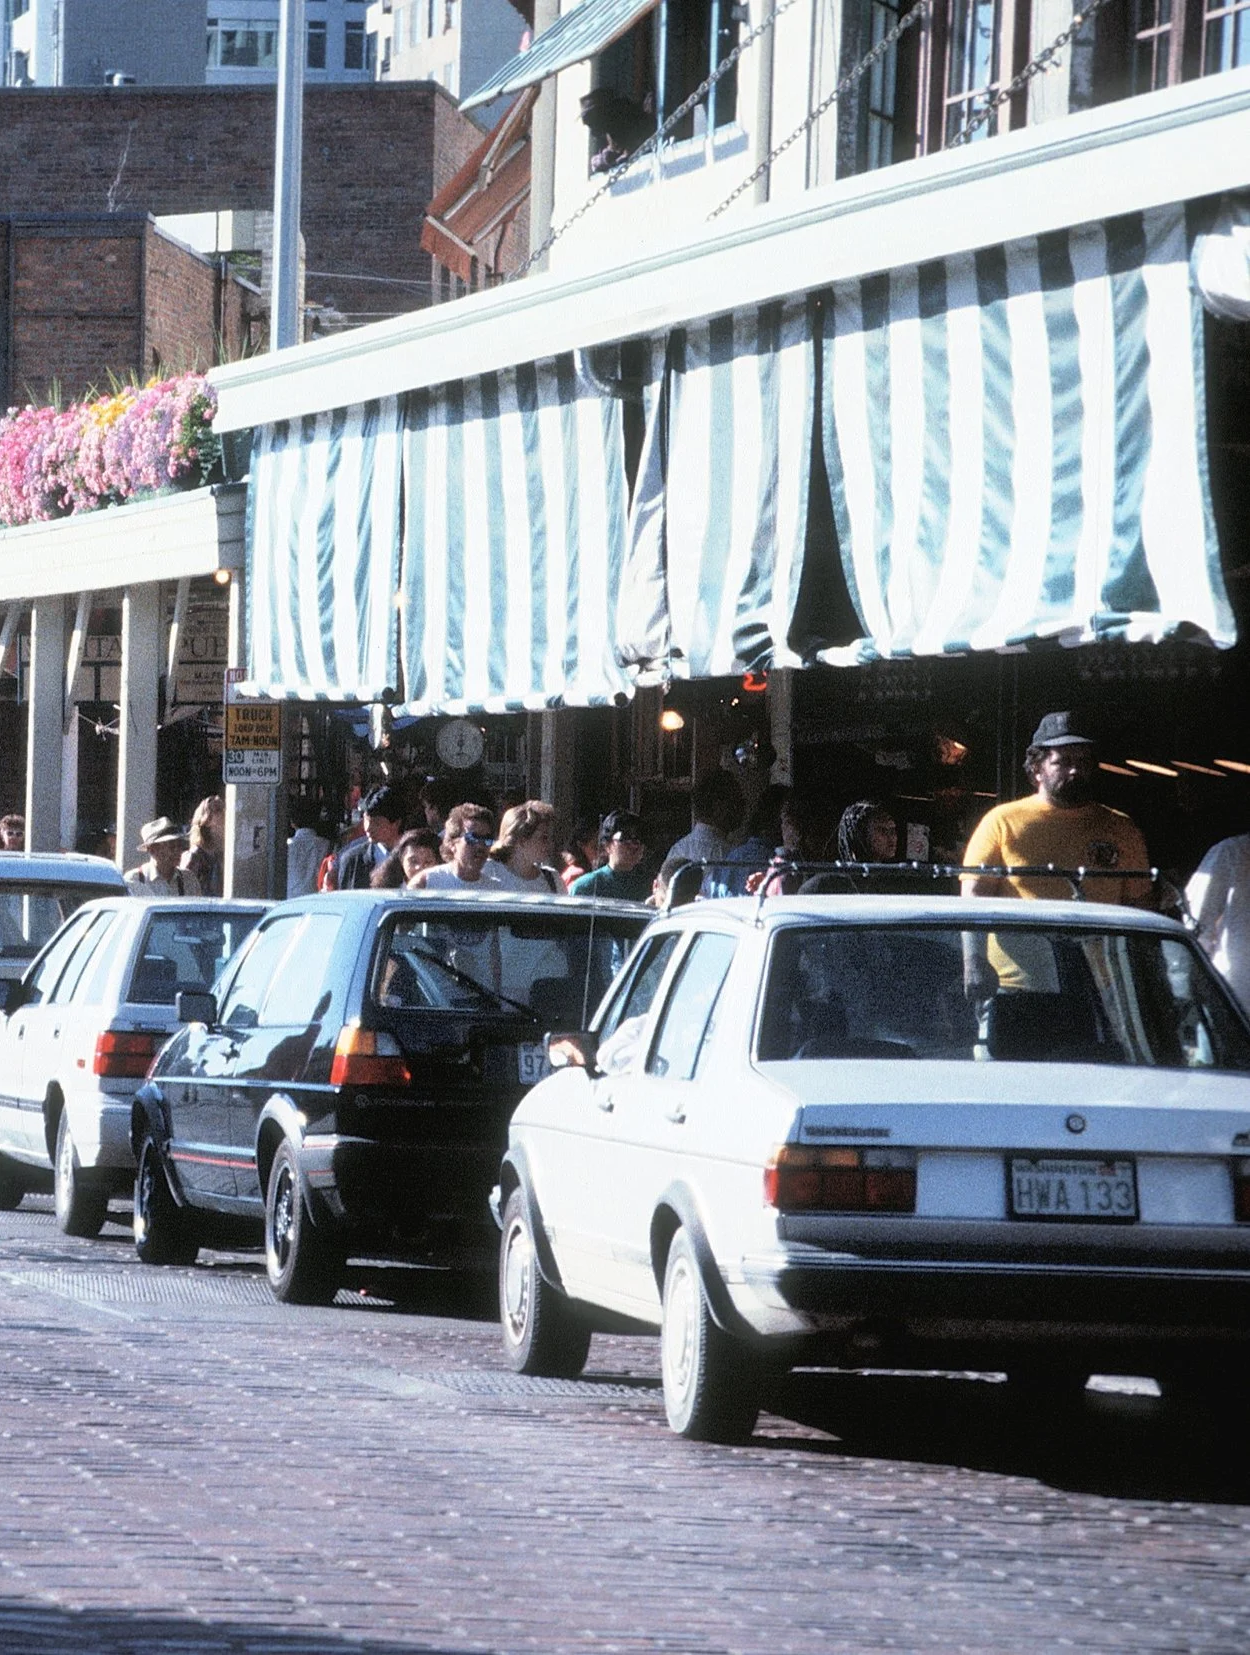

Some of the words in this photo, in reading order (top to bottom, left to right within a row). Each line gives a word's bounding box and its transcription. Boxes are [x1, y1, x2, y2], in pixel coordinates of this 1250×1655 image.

[235, 707, 273, 721] TRUCK
[228, 750, 243, 763] 30
[1015, 1177, 1071, 1209] HWA
[1079, 1180, 1133, 1211] 133
